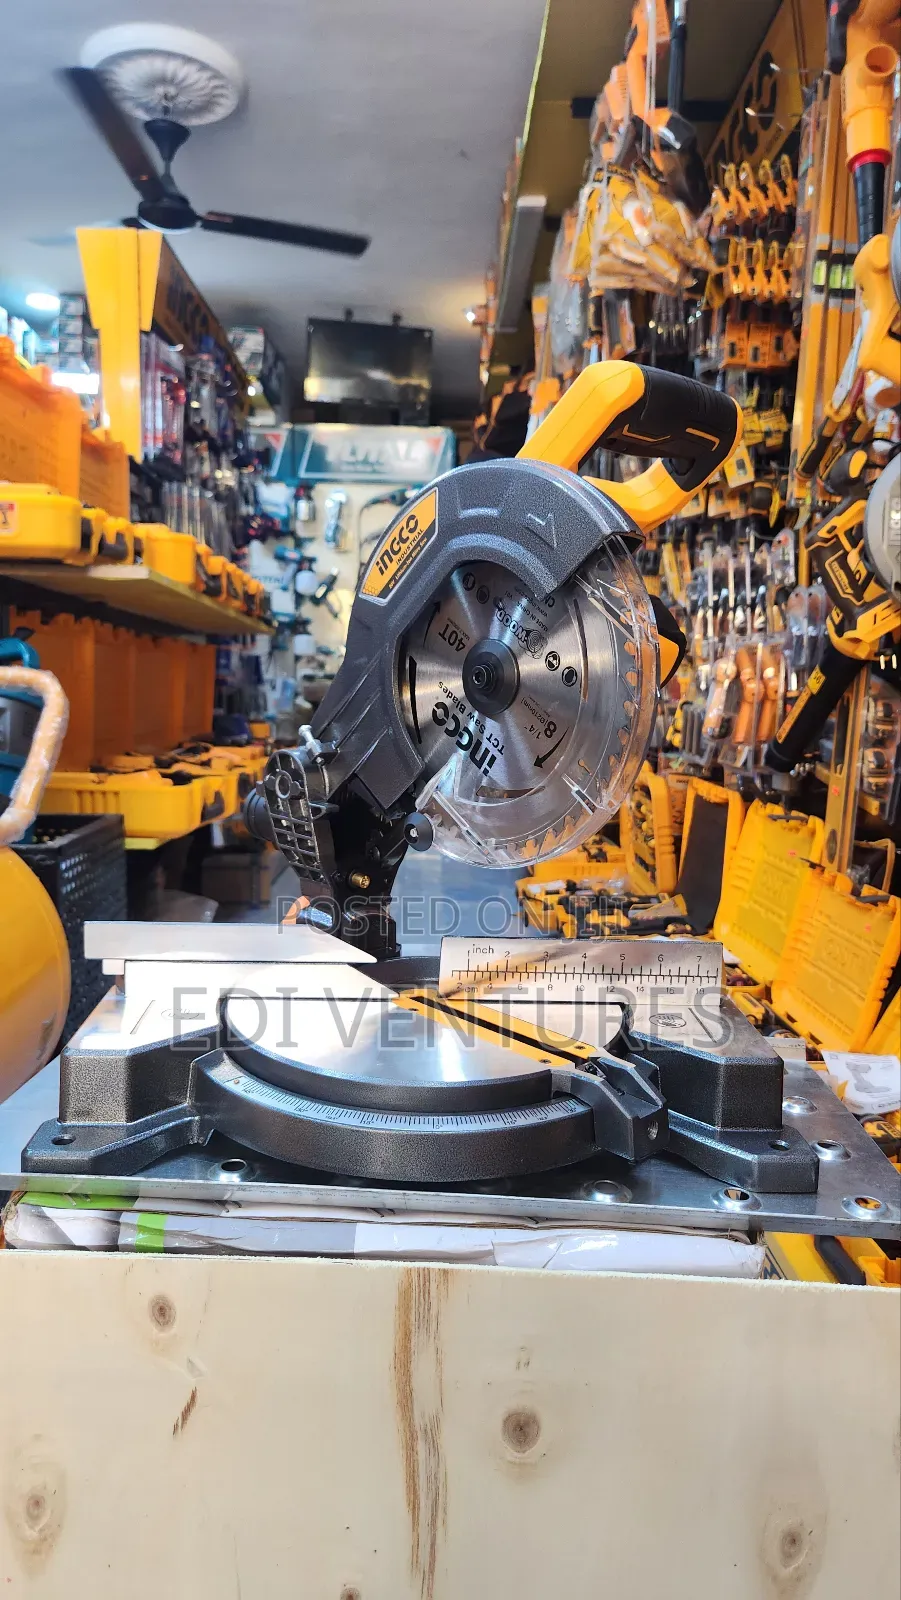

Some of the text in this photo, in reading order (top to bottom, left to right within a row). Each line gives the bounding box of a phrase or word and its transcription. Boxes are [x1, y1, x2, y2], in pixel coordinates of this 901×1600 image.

[438, 623, 466, 652] 40T
[438, 681, 505, 755] TCT Saw Blades
[472, 943, 495, 954] inch
[543, 952, 549, 961] 3
[620, 953, 626, 961] 5
[657, 954, 664, 962] 6
[606, 985, 616, 993] 12
